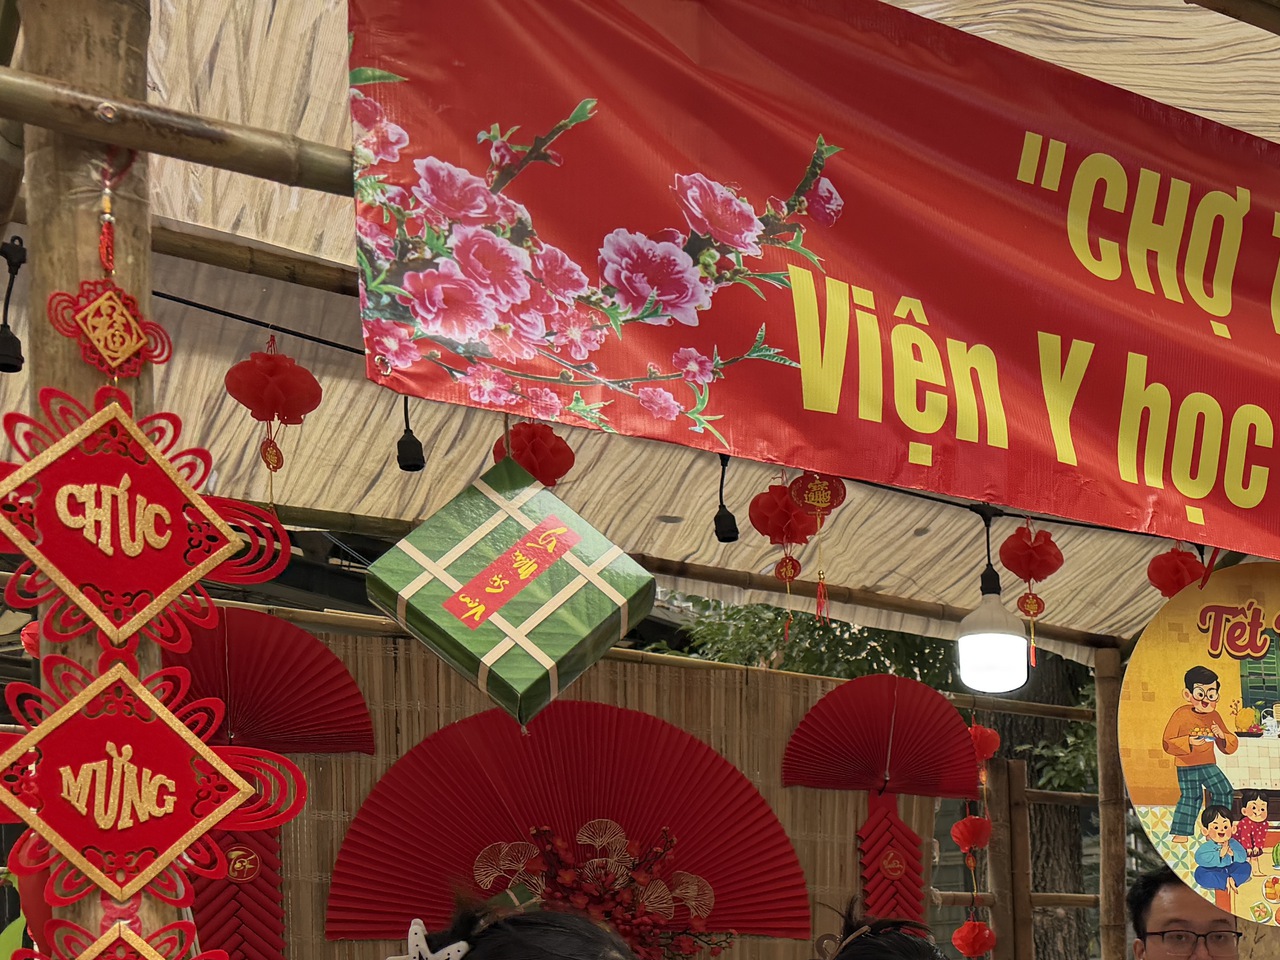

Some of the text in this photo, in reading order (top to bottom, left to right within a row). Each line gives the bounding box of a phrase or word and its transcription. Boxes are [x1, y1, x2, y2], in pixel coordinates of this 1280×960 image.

[1017, 131, 1250, 339] "CHỢ
[788, 264, 1008, 467] Viện
[1037, 330, 1095, 467] Y
[1118, 352, 1274, 525] học
[55, 473, 172, 557] CHÚC
[1200, 600, 1269, 659] Tết
[59, 740, 178, 831] MỪNG
